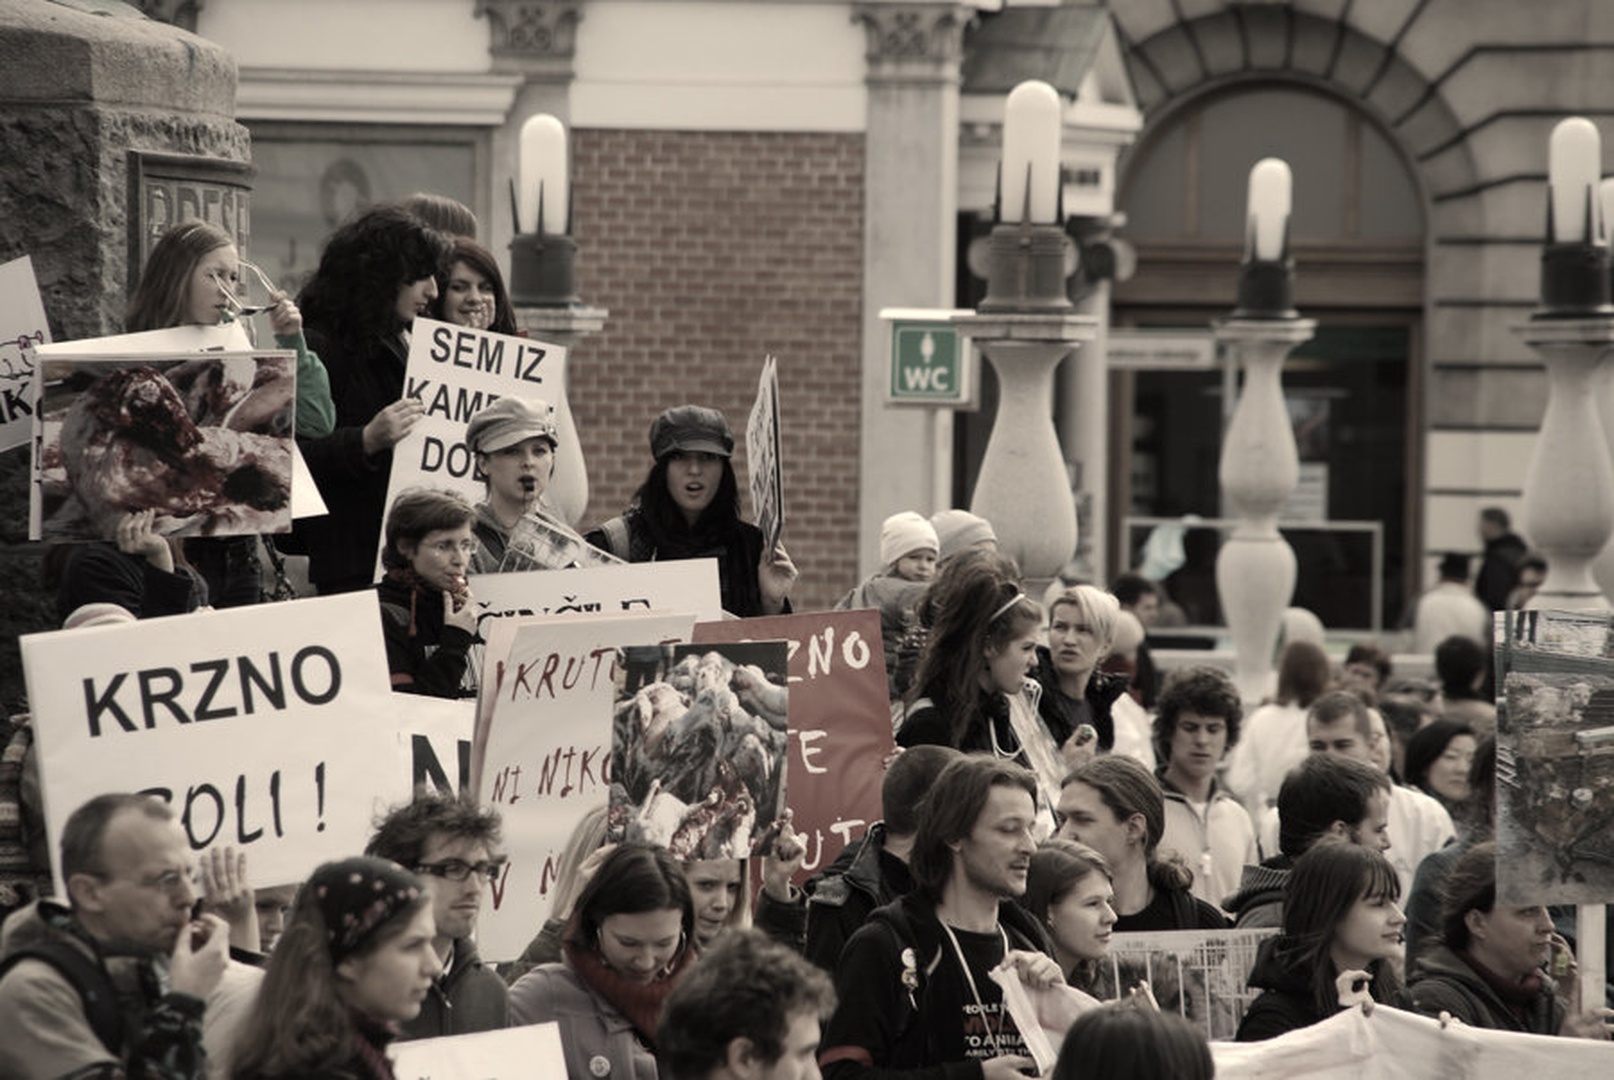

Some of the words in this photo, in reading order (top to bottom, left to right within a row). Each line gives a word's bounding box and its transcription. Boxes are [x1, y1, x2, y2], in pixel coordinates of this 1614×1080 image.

[430, 327, 505, 376] SEM
[514, 345, 547, 384] IZ
[904, 366, 948, 390] WC
[406, 377, 501, 424] KAM
[83, 645, 342, 737] KRZNO
[135, 769, 283, 850] OLI
[492, 765, 521, 804] NI
